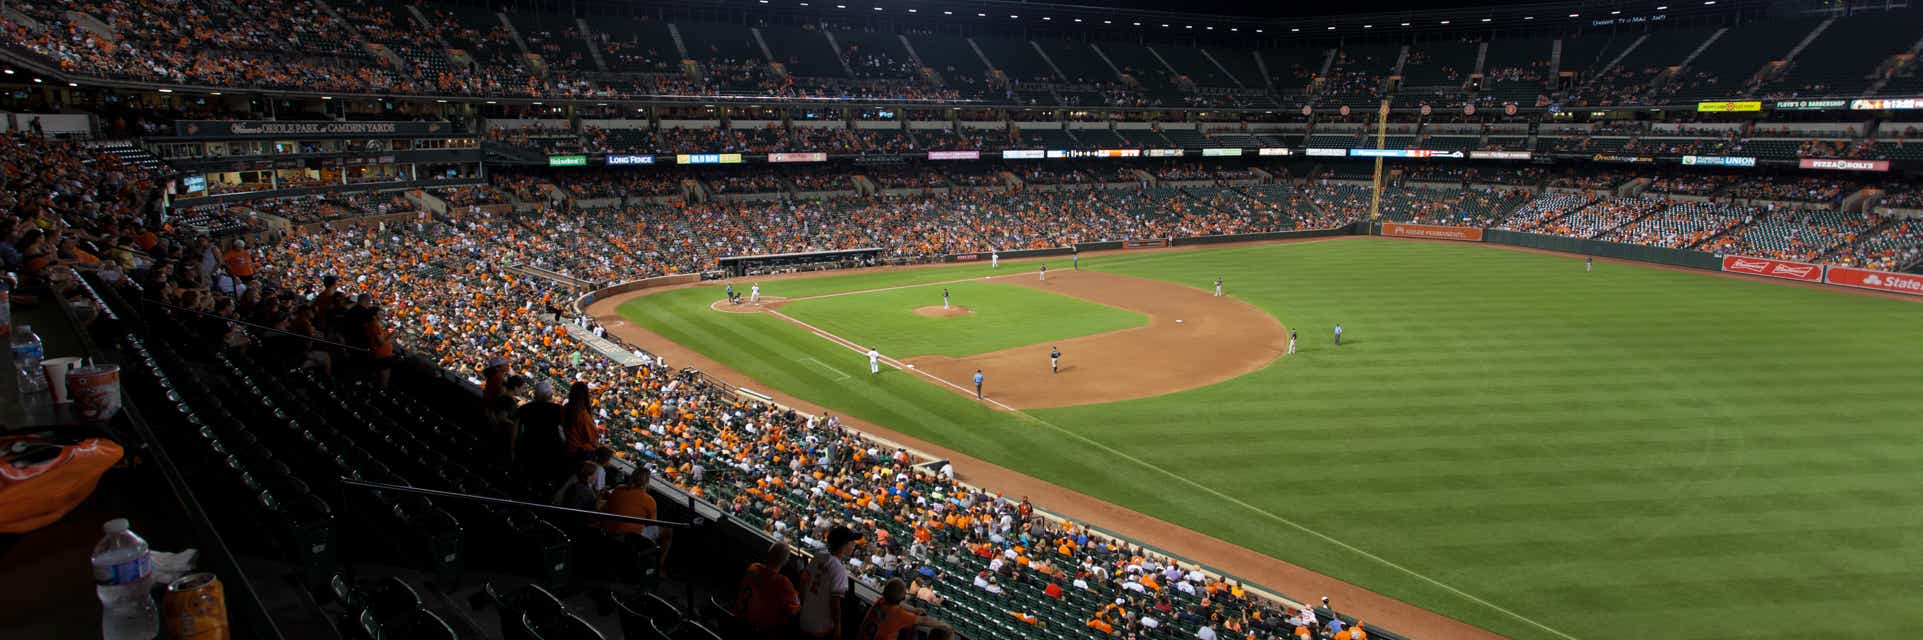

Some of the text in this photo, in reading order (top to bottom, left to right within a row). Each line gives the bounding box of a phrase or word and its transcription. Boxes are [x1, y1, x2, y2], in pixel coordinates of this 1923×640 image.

[262, 123, 294, 134] ORIOLE
[296, 123, 320, 133] PARK
[327, 123, 366, 133] CAMDEN
[366, 123, 395, 133] YARDS
[609, 155, 652, 164] LONG FENCE
[691, 154, 719, 163] OLD BAY
[1726, 156, 1756, 167] UNION
[1812, 160, 1837, 168] PIZZA
[1884, 276, 1920, 290] State
